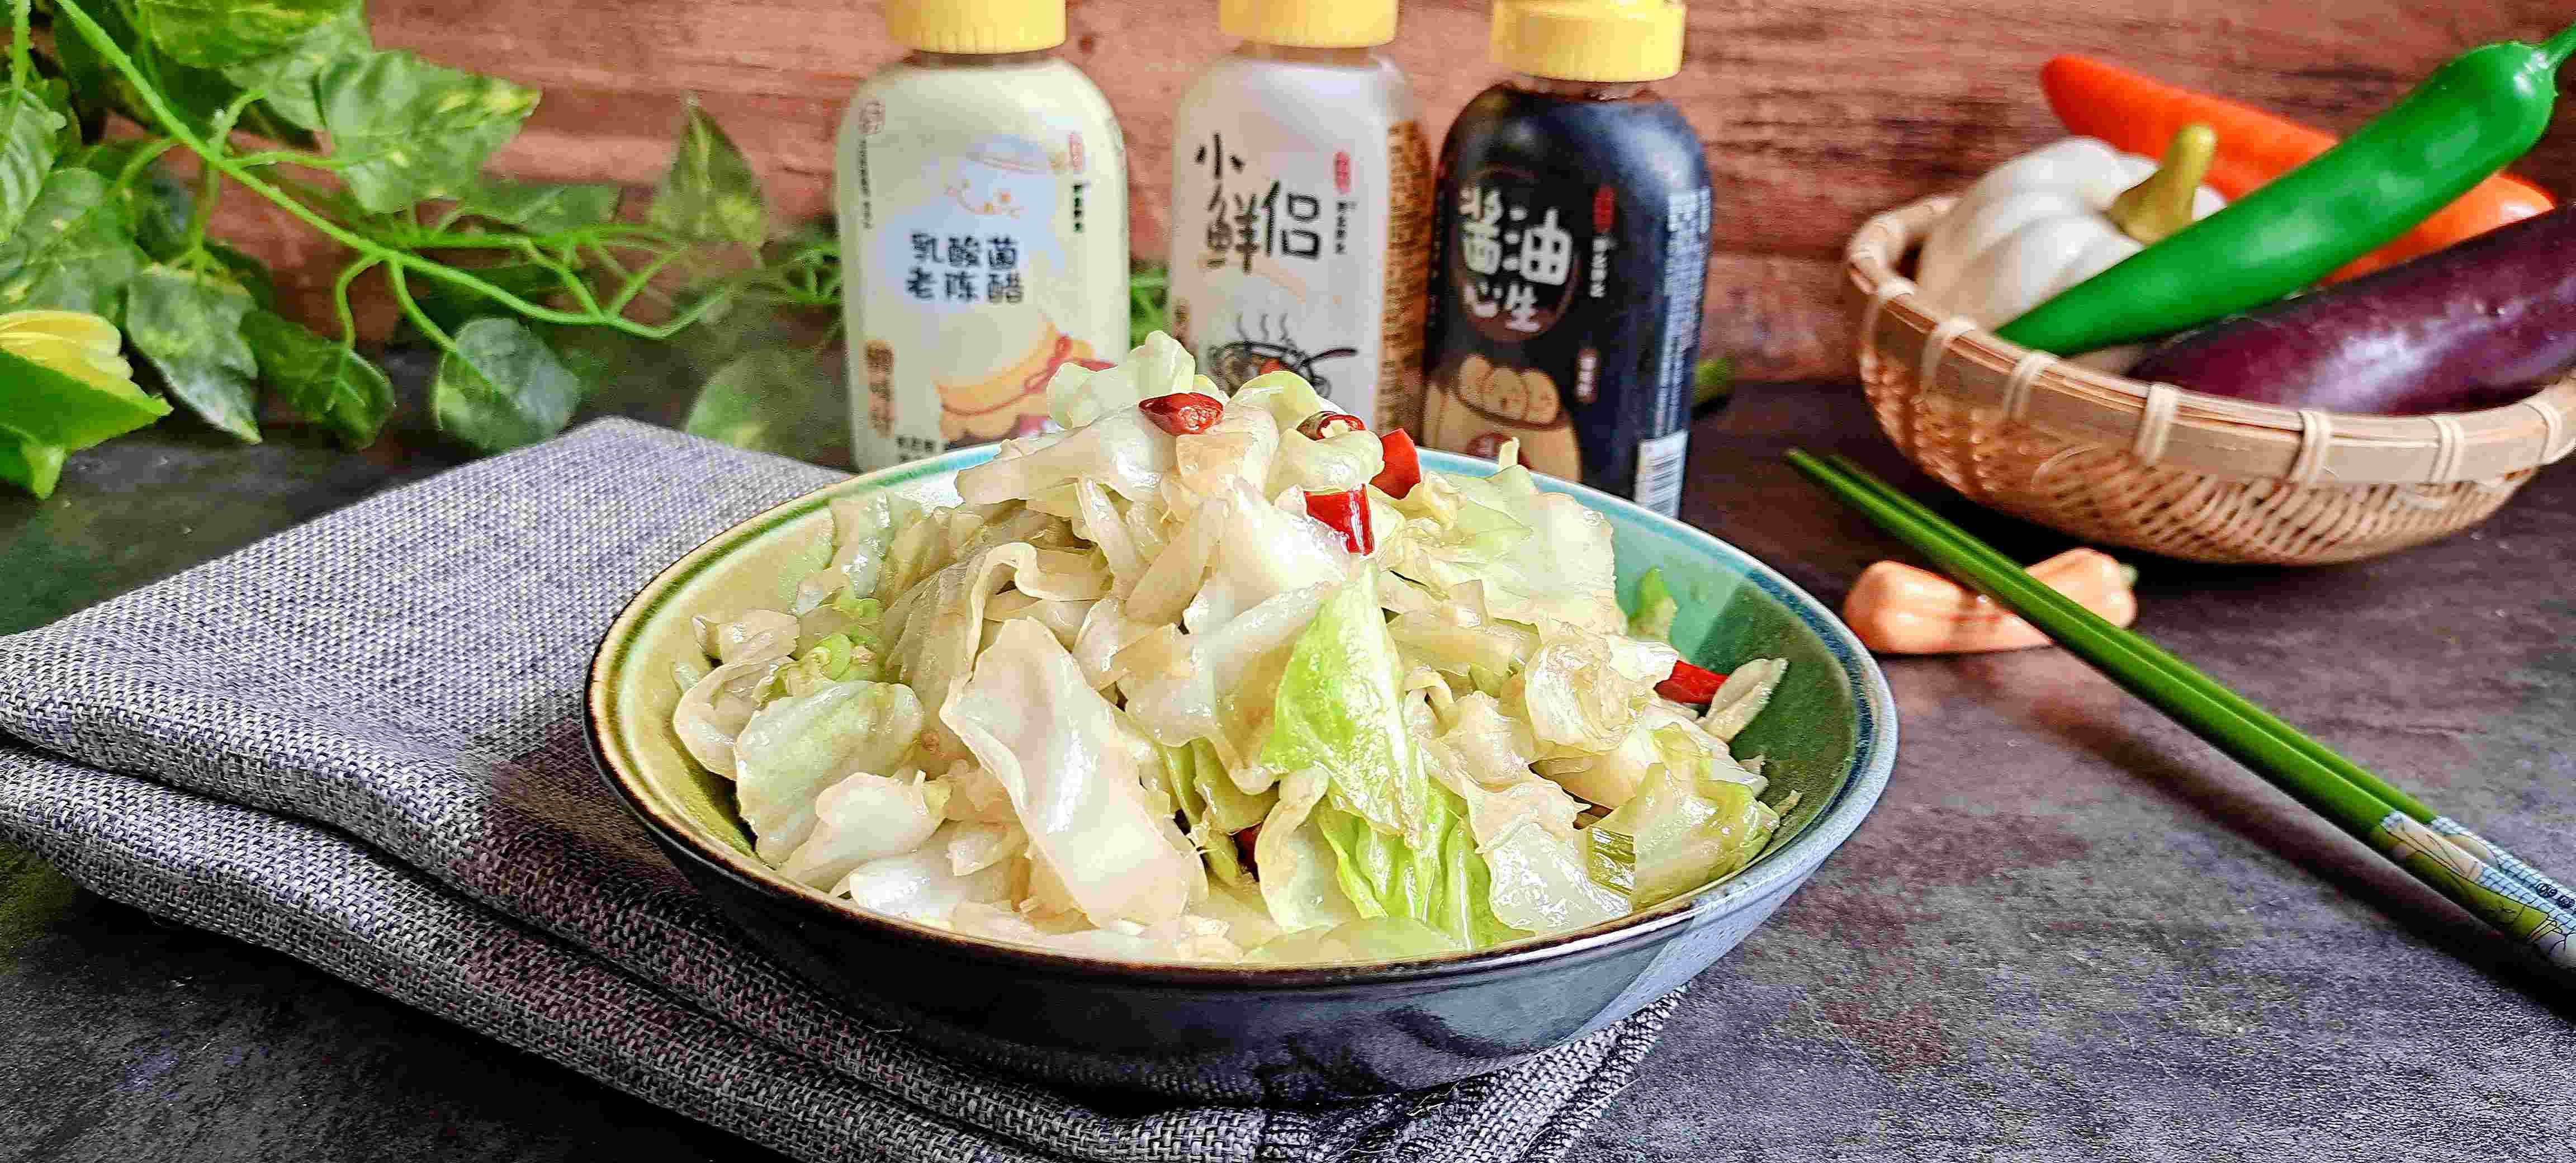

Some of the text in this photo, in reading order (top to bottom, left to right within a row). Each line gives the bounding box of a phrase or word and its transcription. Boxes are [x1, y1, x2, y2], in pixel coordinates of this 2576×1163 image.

[911, 232, 1017, 268] 乳酸菌
[1458, 186, 1573, 286] 酱油
[905, 267, 1024, 304] 老陈醋
